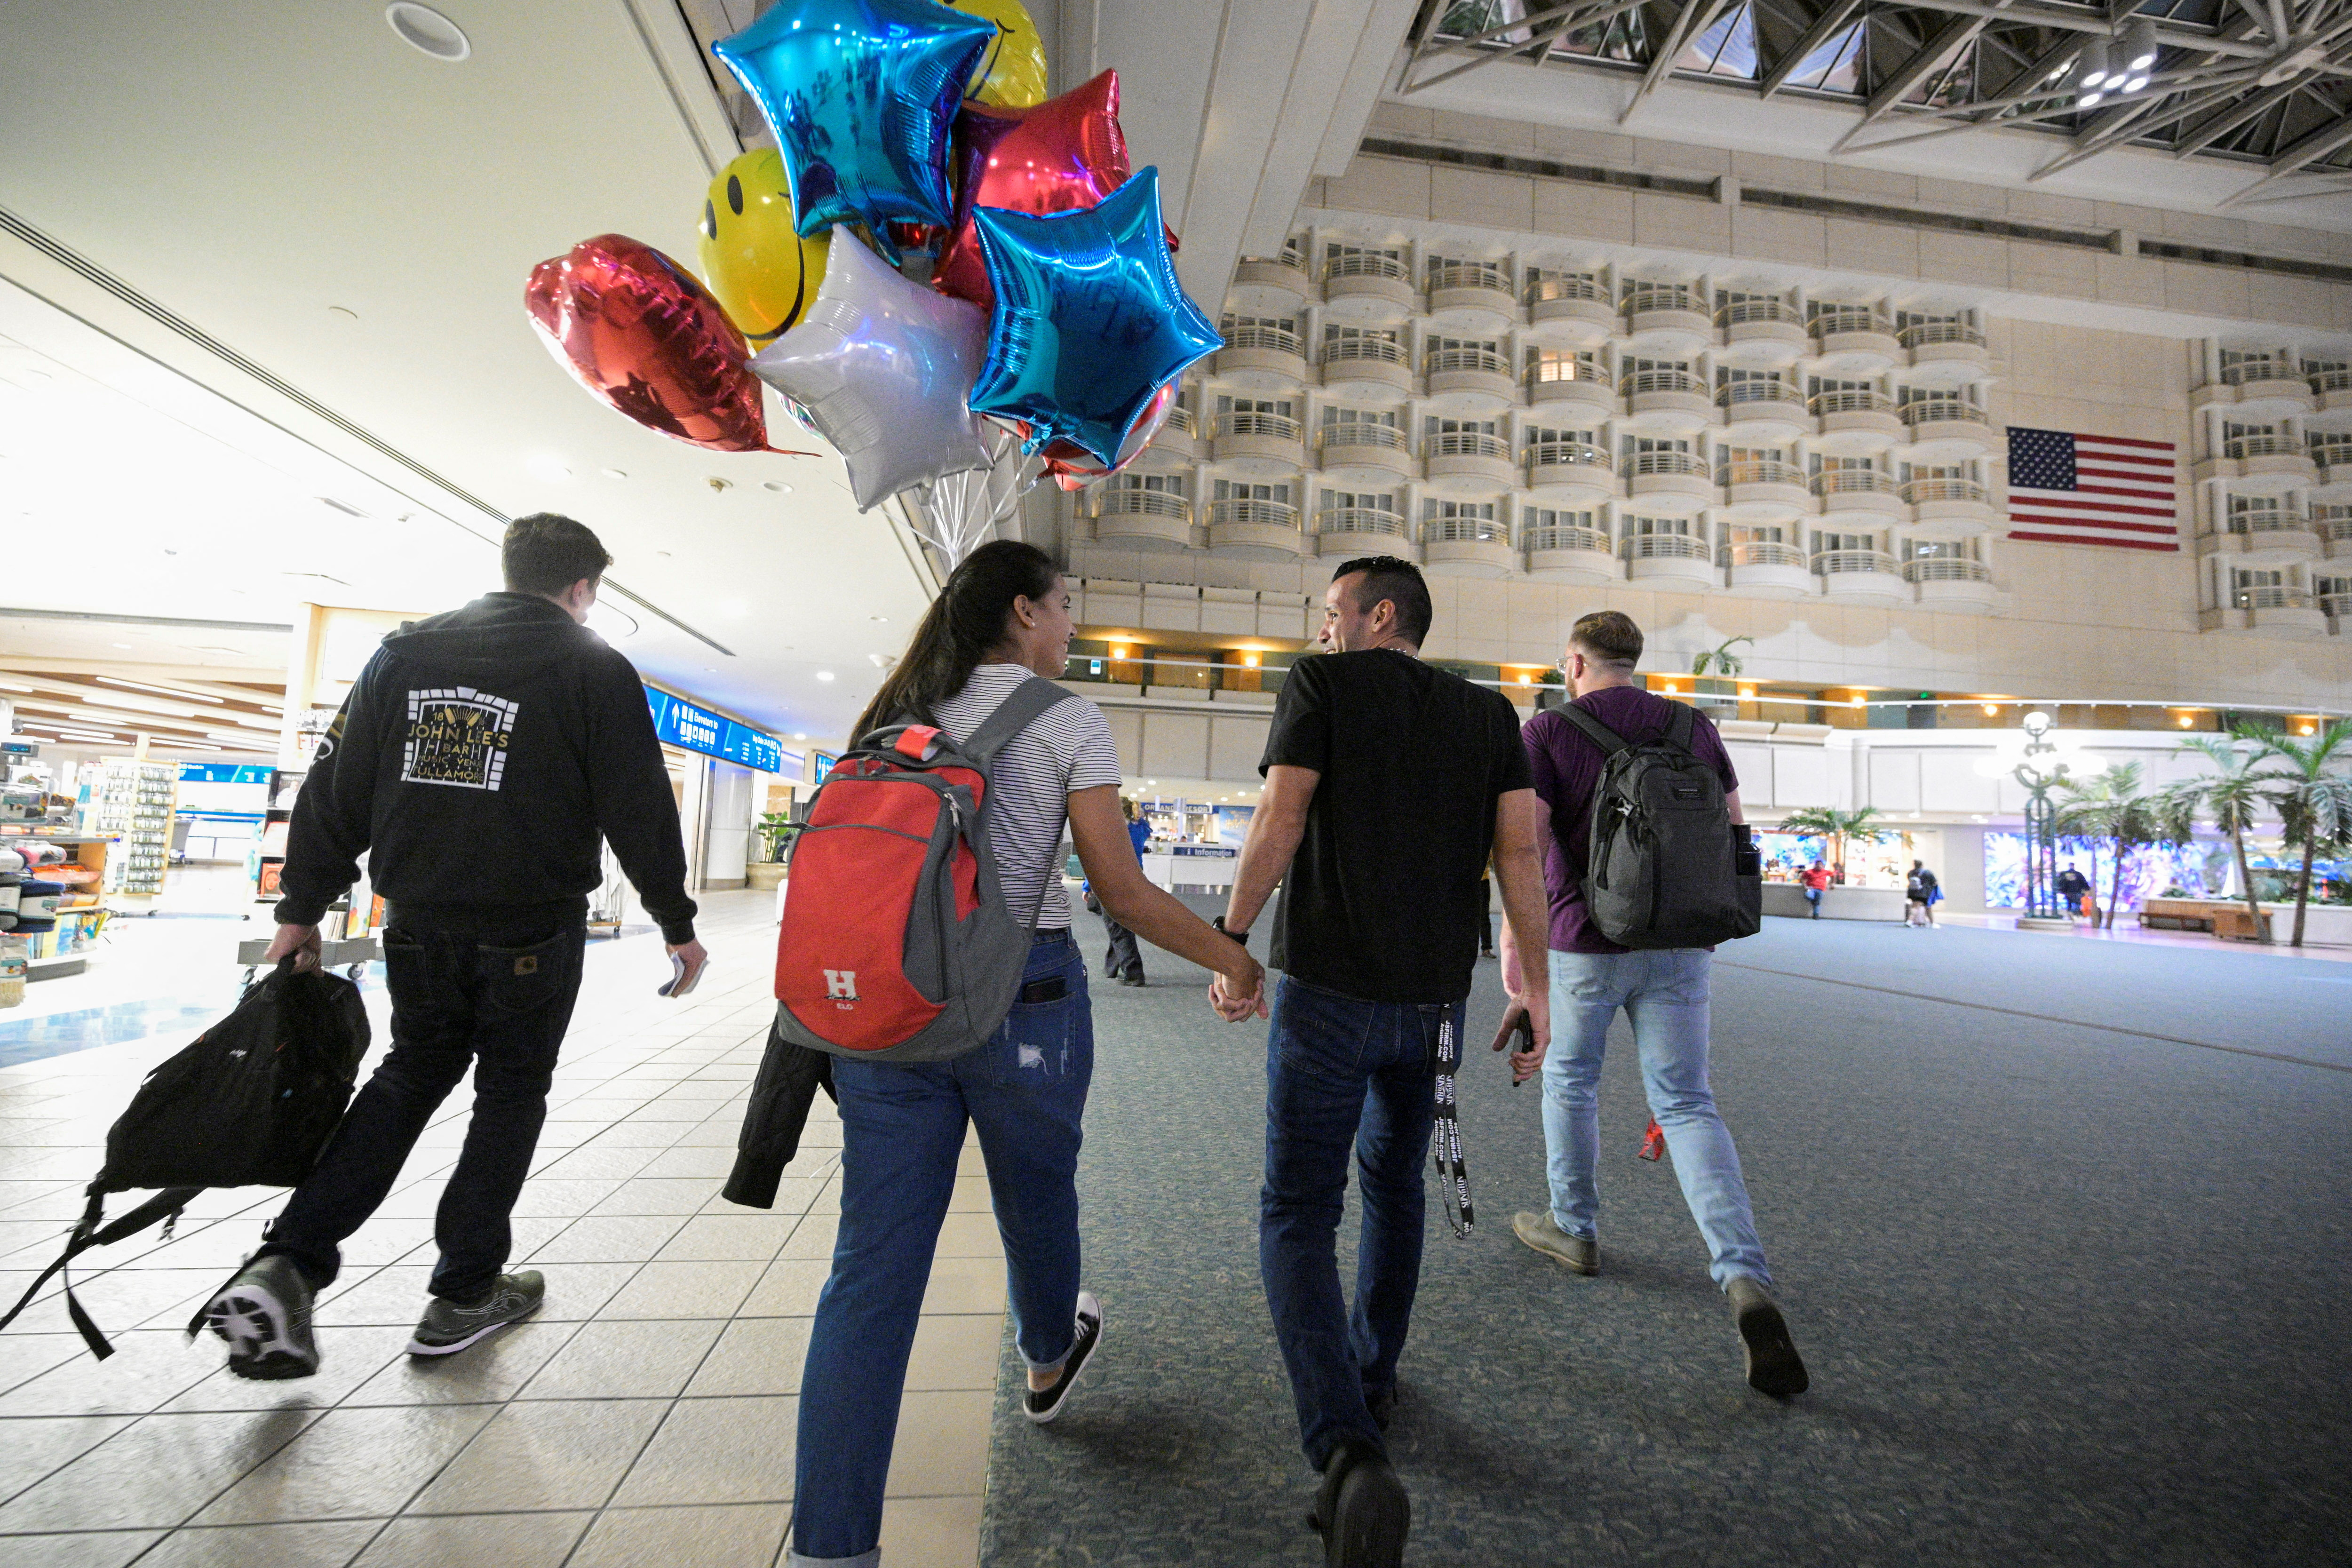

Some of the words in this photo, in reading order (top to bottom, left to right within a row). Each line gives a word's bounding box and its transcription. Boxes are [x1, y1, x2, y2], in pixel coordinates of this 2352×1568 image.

[433, 712, 444, 721] 18
[694, 712, 713, 728] Elevators
[713, 720, 718, 730] to
[408, 724, 460, 741] JOHN
[467, 729, 509, 748] LEE'S
[443, 743, 469, 755] BAR
[418, 755, 449, 764] MUSIC
[413, 765, 485, 781] TULLAMORE
[824, 969, 856, 998] H
[1447, 1118, 1458, 1163] JSFIRM.COM
